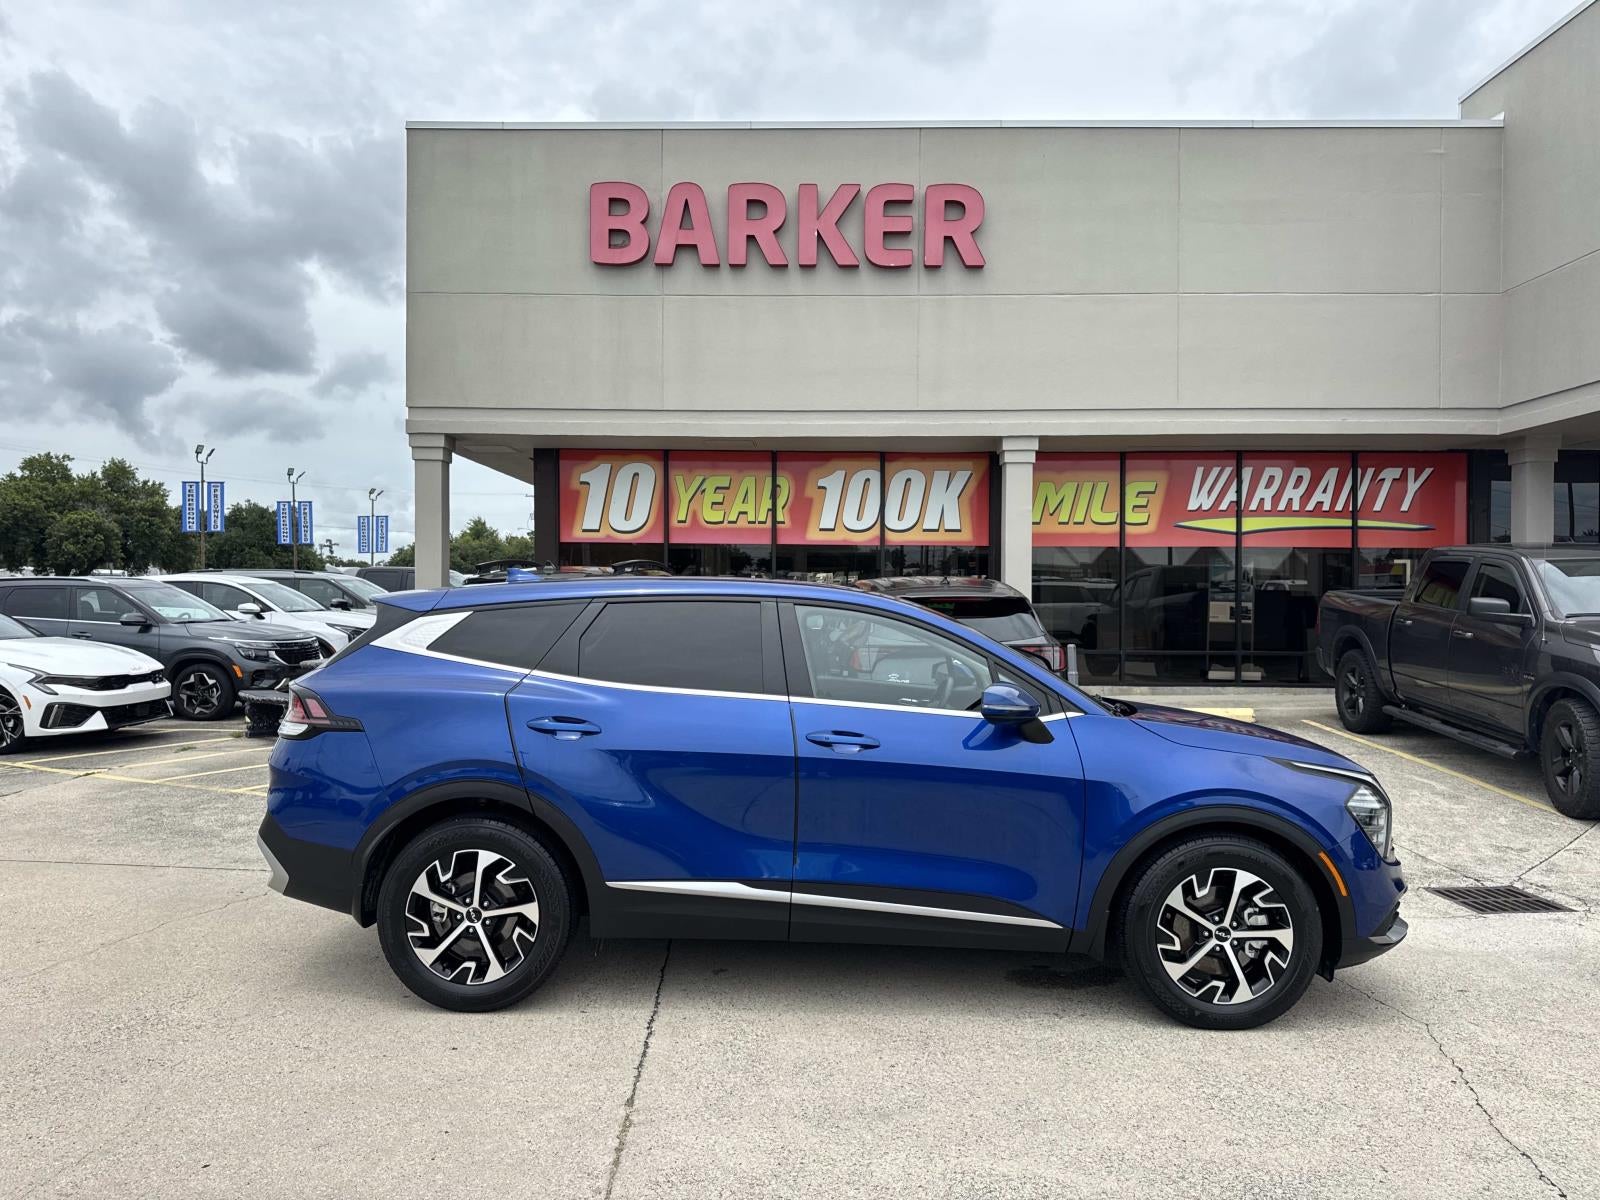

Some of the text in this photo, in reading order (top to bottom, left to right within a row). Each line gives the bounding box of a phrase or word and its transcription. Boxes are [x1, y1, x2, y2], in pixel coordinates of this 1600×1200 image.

[589, 181, 987, 269] BARKER
[578, 462, 1436, 535] 10 YEAR 100K MILE WARRANTY
